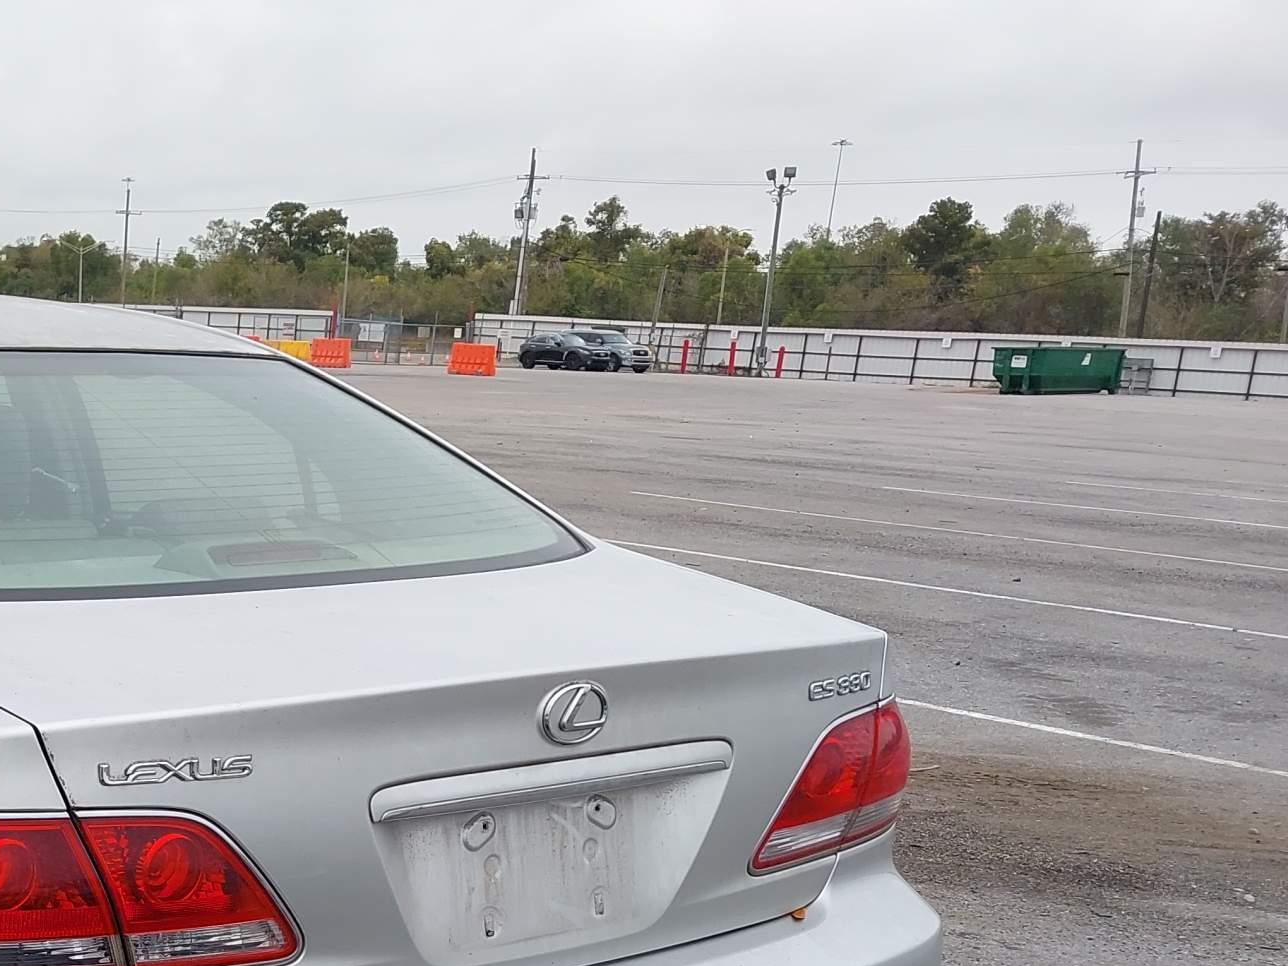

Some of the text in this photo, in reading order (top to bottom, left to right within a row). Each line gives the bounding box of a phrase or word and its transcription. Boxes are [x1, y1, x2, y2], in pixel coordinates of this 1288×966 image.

[809, 671, 872, 701] ES 330
[98, 754, 253, 786] LEXUS
